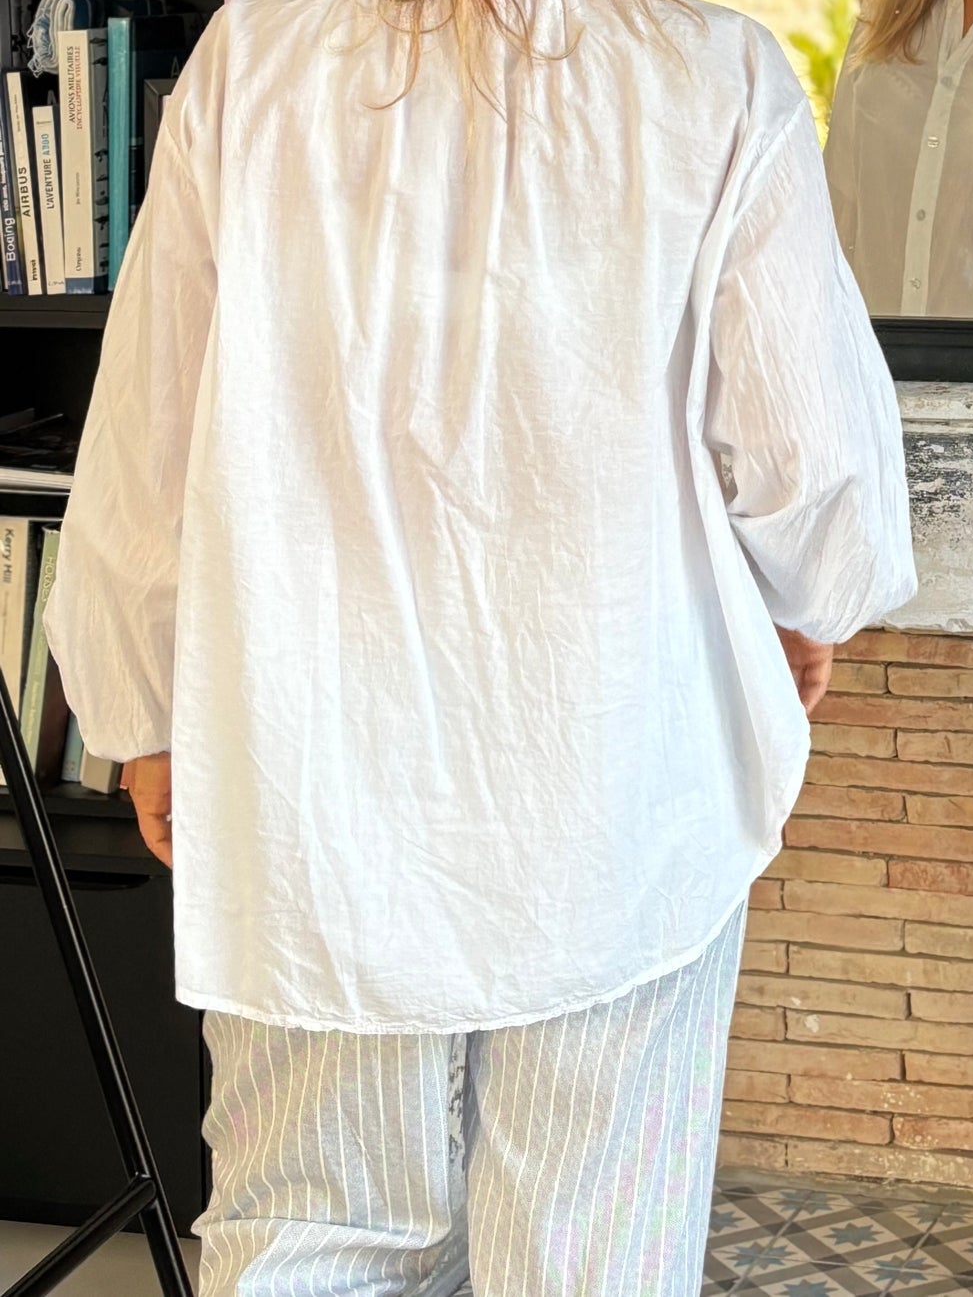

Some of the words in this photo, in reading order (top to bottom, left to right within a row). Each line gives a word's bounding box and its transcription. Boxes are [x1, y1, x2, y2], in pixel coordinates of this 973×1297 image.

[66, 46, 75, 91] MILITAIRES
[68, 92, 76, 124] AVIONS
[18, 166, 31, 218] AIRBUS
[43, 158, 55, 210] L'AVENTURE
[2, 528, 15, 561] Kerry
[3, 564, 13, 584] Hill
